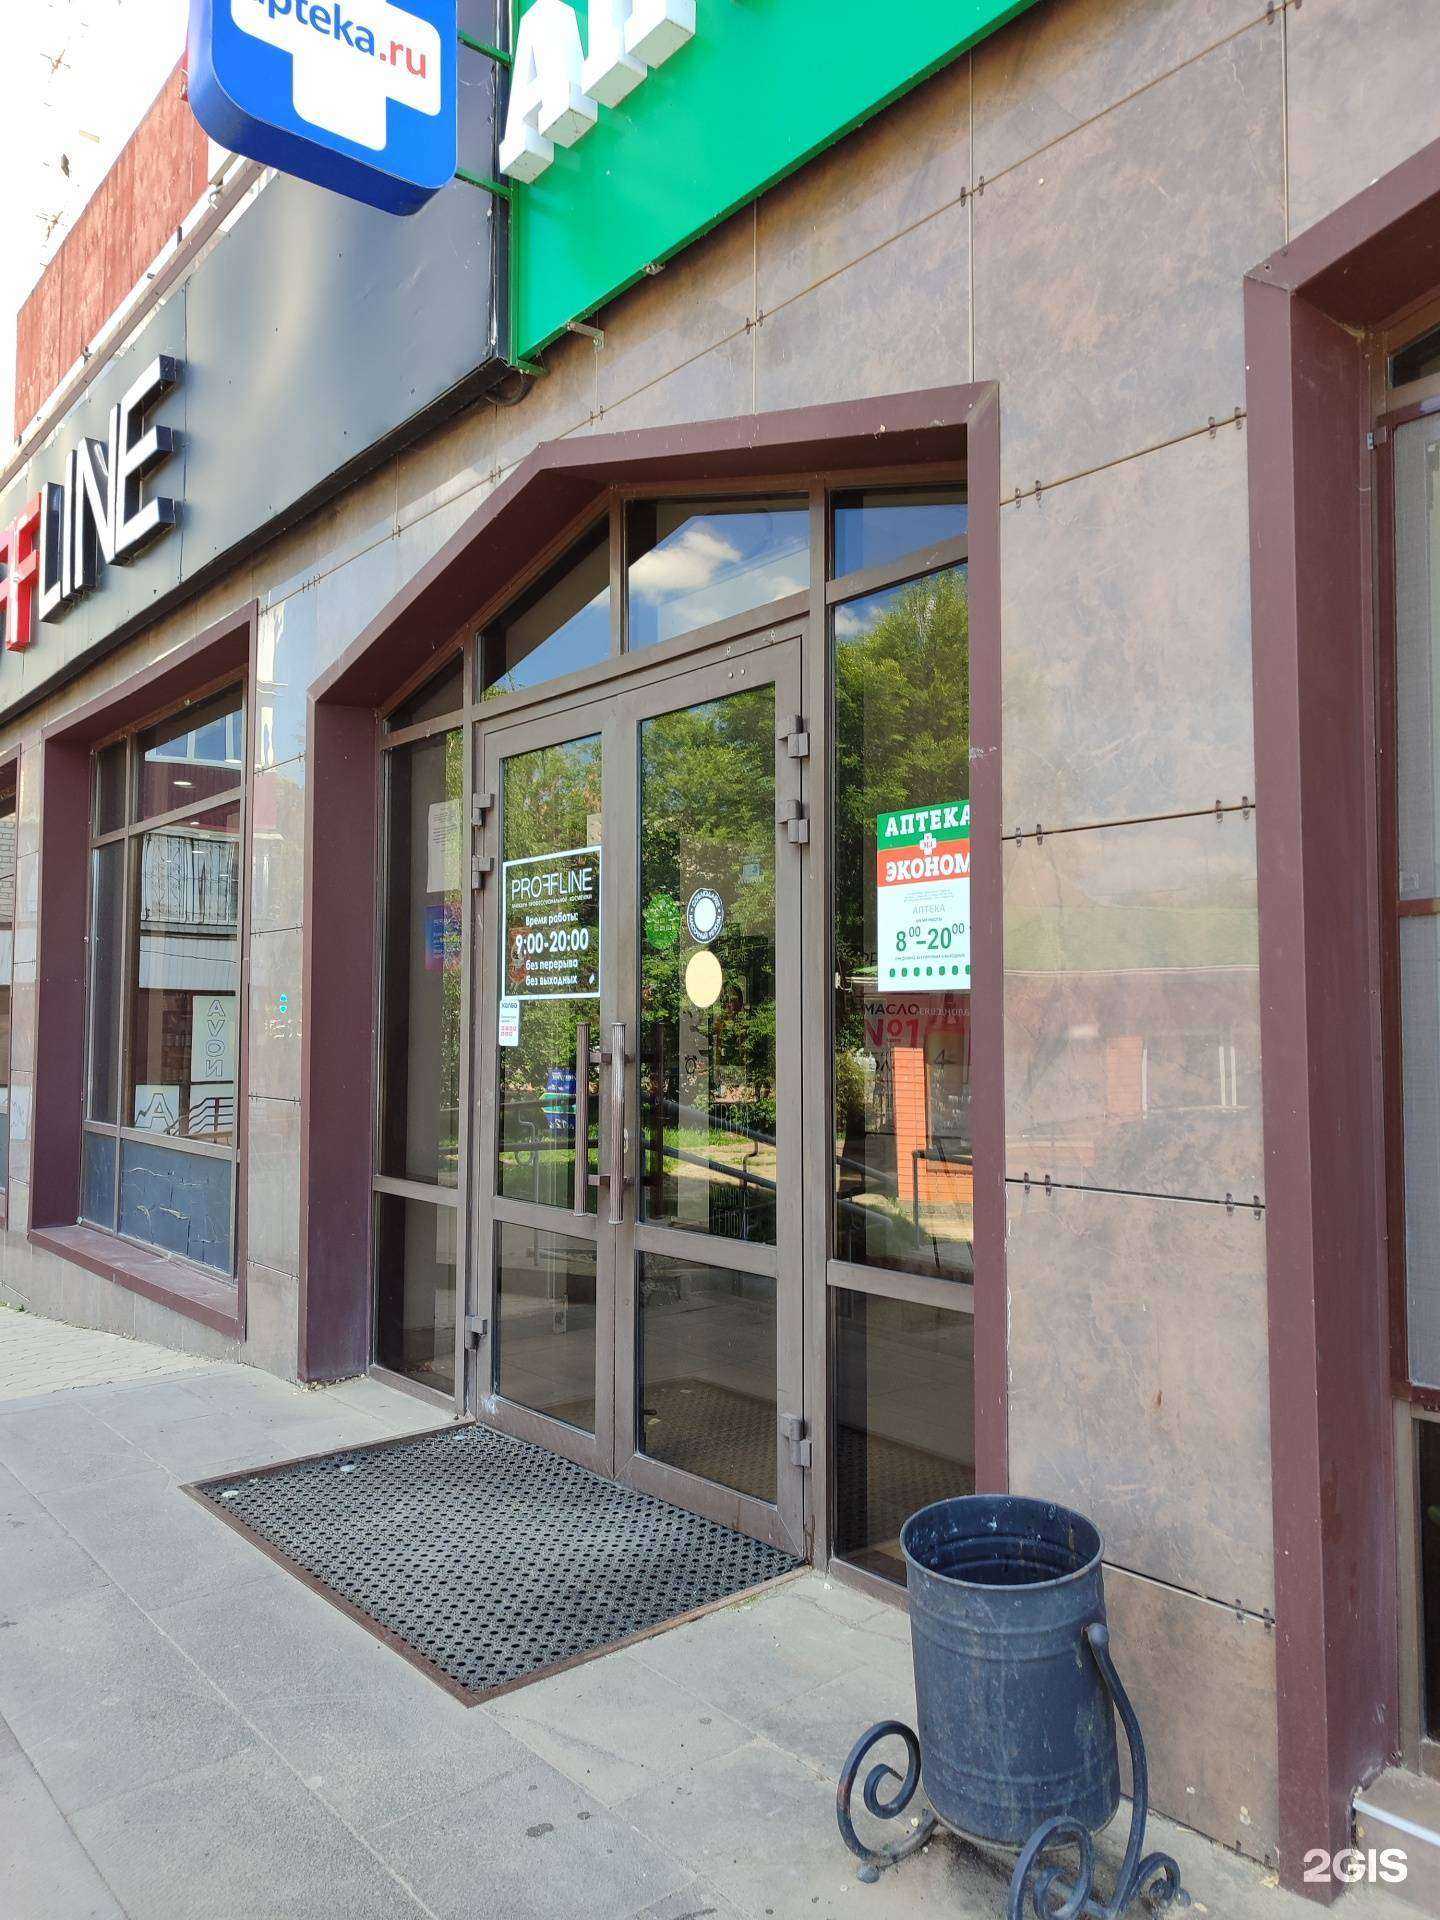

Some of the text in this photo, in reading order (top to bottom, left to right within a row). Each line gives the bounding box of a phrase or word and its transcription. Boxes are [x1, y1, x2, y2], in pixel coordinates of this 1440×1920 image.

[253, 0, 427, 79] pteka.ru
[885, 804, 970, 837] АПТЕКА
[886, 852, 970, 882] ЭКОНОМ
[515, 927, 589, 955] 9:00-20:00
[525, 960, 538, 970] без
[525, 975, 538, 986] без
